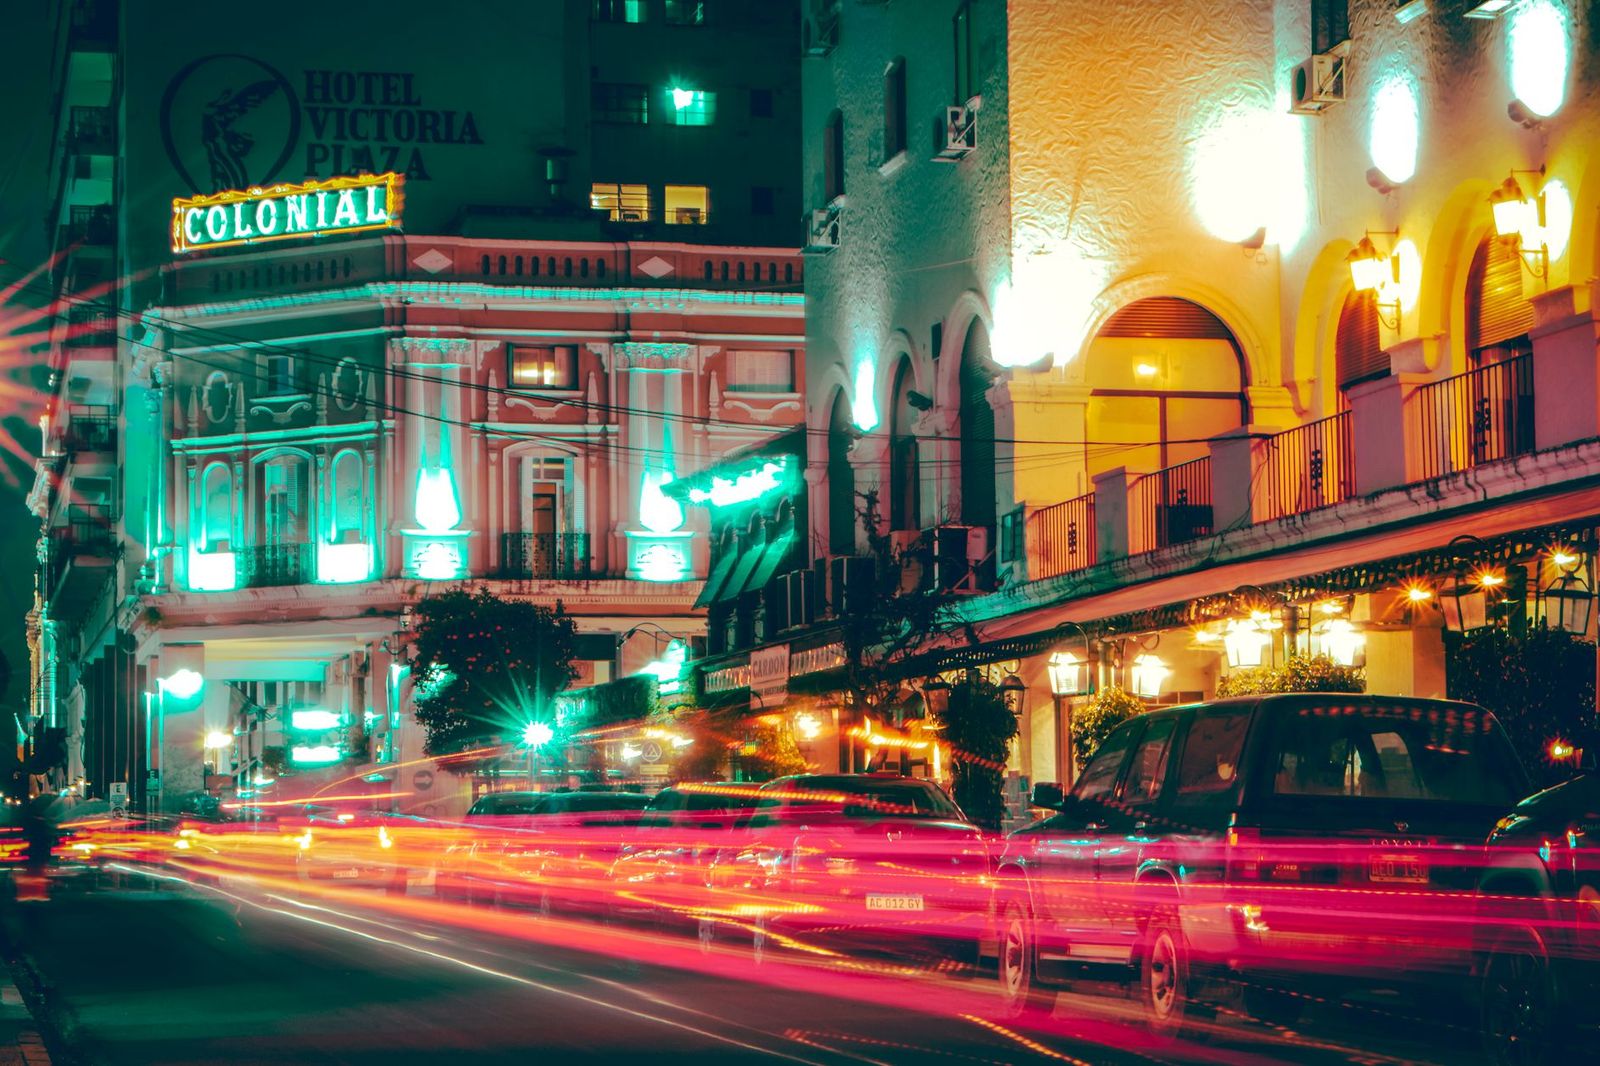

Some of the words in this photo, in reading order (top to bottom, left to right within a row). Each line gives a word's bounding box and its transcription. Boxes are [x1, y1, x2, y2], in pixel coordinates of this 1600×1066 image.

[304, 70, 420, 106] HOTEL
[304, 108, 483, 144] VICTORIA
[304, 143, 431, 181] PLAZA
[184, 186, 389, 244] COLONIAL
